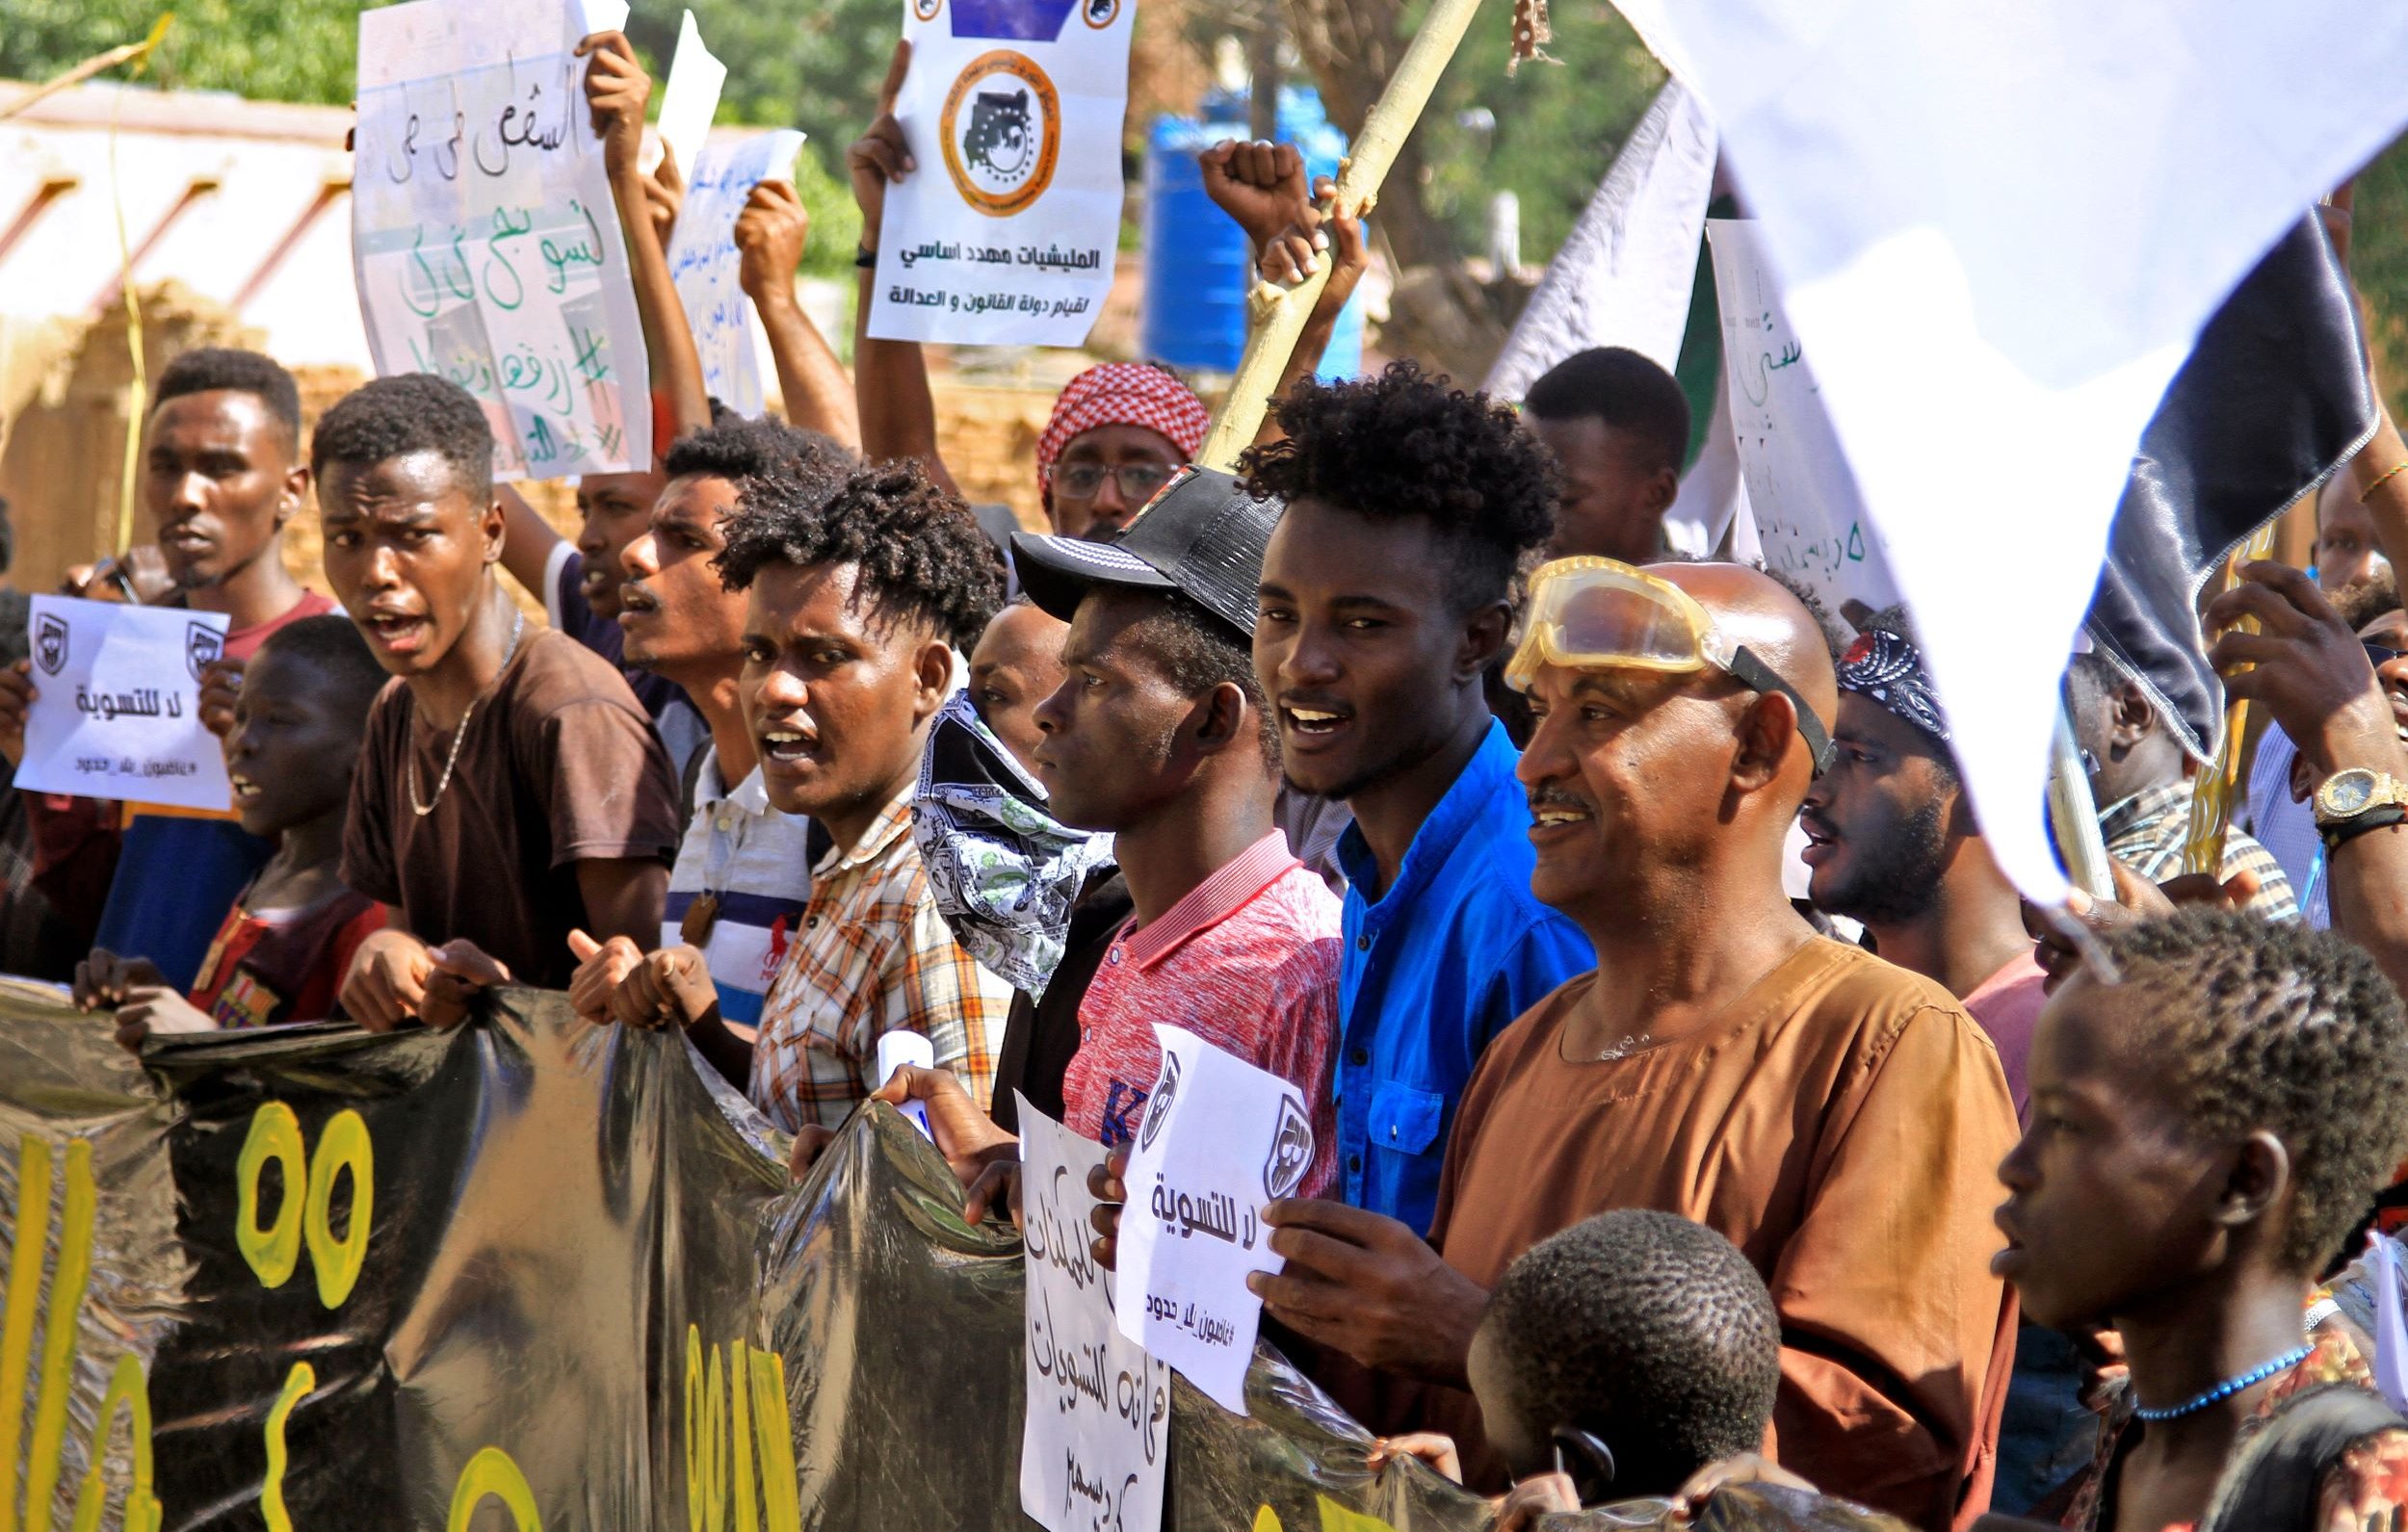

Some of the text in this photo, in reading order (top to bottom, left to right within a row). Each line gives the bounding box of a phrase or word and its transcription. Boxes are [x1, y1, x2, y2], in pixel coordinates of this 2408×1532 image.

[966, 246, 1013, 265] مهدد
[1017, 242, 1100, 272] المليشيات
[890, 284, 1089, 318] لقيام دولة القانون و العدالة
[75, 683, 182, 720] لا للتسوية
[1152, 1172, 1258, 1252] لا للتسوية
